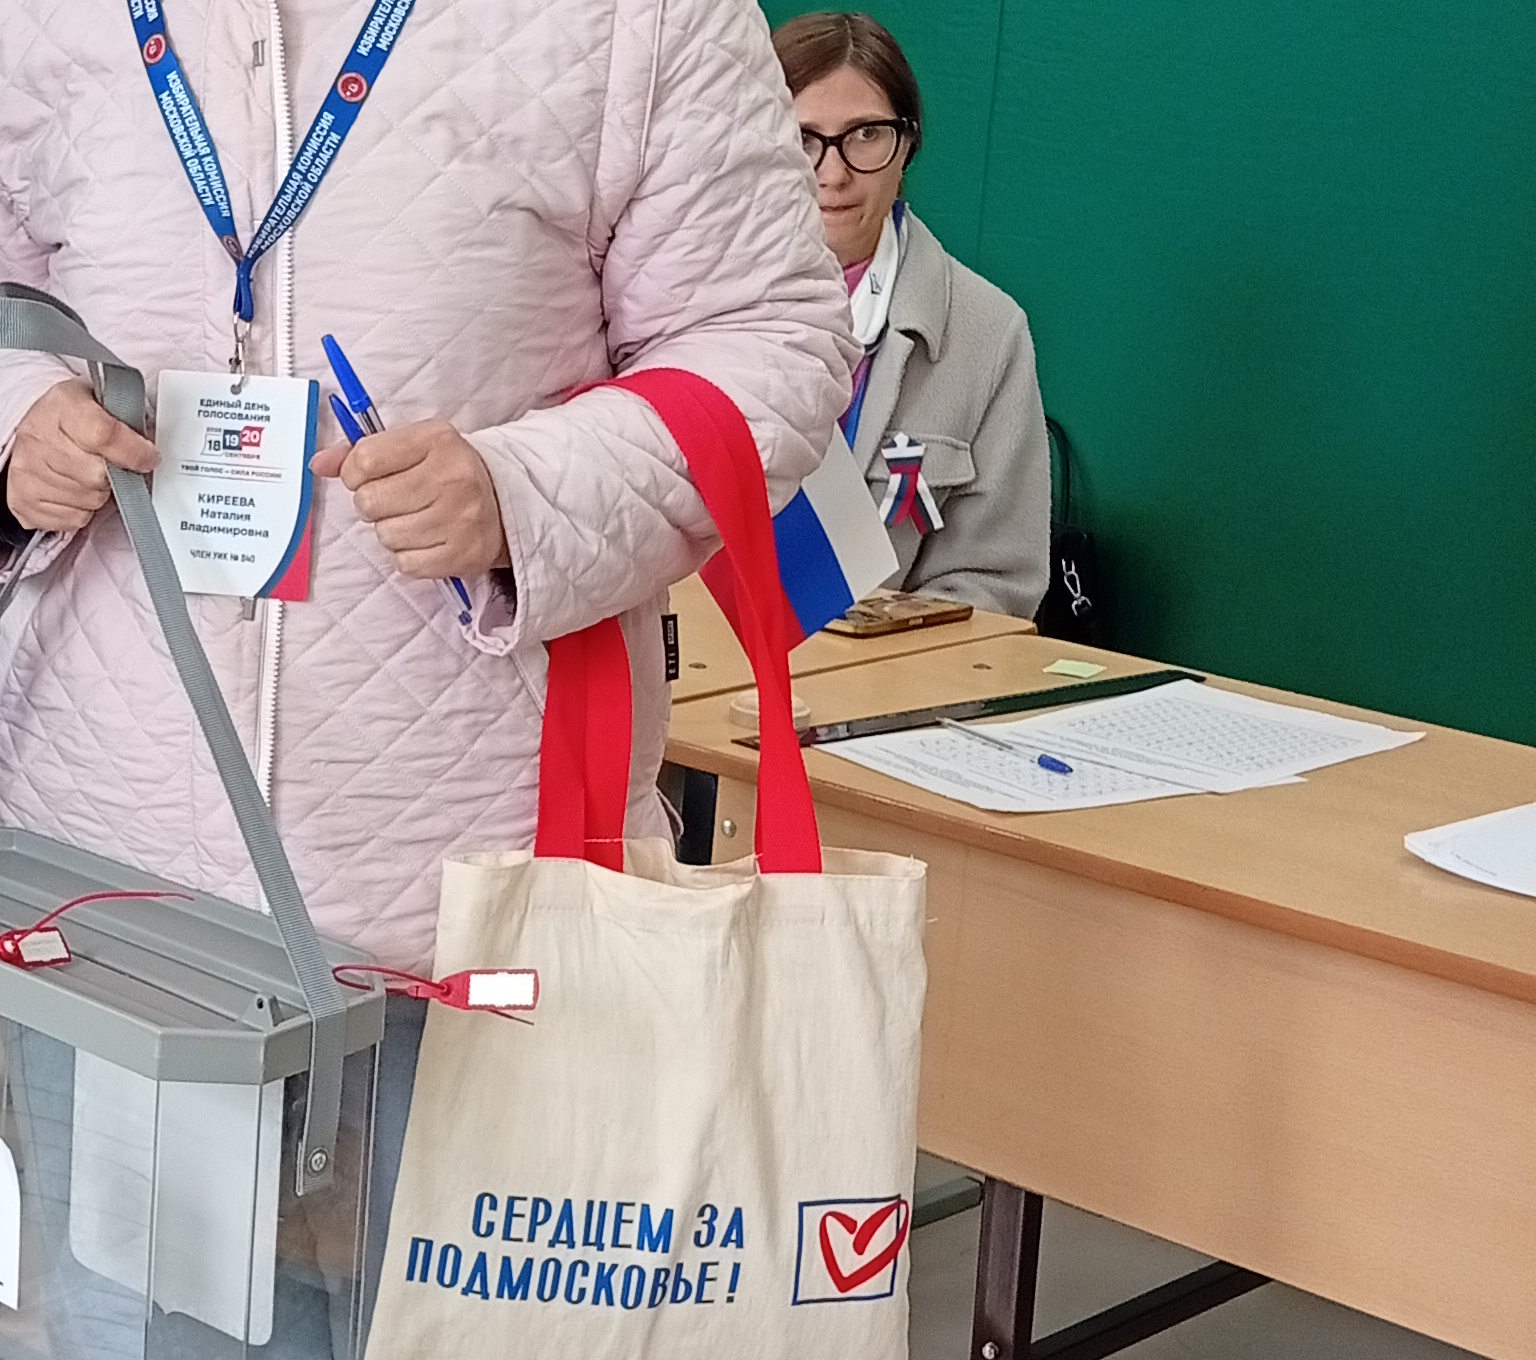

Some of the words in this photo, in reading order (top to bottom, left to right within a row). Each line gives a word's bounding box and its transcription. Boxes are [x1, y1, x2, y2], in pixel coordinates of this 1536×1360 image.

[158, 90, 198, 159] МОСКОВСКОЙ
[186, 158, 215, 206] ОБЛАСТИ
[166, 70, 210, 156] ИЗБИРАТЕЛЬНАЯ
[201, 155, 231, 218] КОМИССИЯ
[247, 172, 303, 259] ИЗБИРАТЕЛЬНАЯ
[296, 111, 335, 173] КОМИССИЯ
[260, 181, 314, 251] МОСКОВСКОЙ
[306, 131, 342, 183] ОБЛАСТИ
[200, 398, 241, 409] ЕДИНЫЙ
[244, 402, 270, 411] ДЕНЬ
[197, 409, 271, 423] ГОЛОСОВАНИЯ
[207, 439, 221, 451] 18
[224, 434, 239, 447] 19
[241, 430, 260, 443] 20
[197, 493, 256, 508] КИРЕЕВА
[200, 508, 251, 522] Наталия
[180, 521, 269, 538] Владимировна
[190, 549, 211, 559] ЧЛЕН
[212, 551, 229, 561] УИК
[470, 1191, 676, 1255] СЕРДЦЕМ
[693, 1203, 746, 1250] ЗА
[405, 1236, 742, 1311] ПОДМОСКОВЬЕ!
